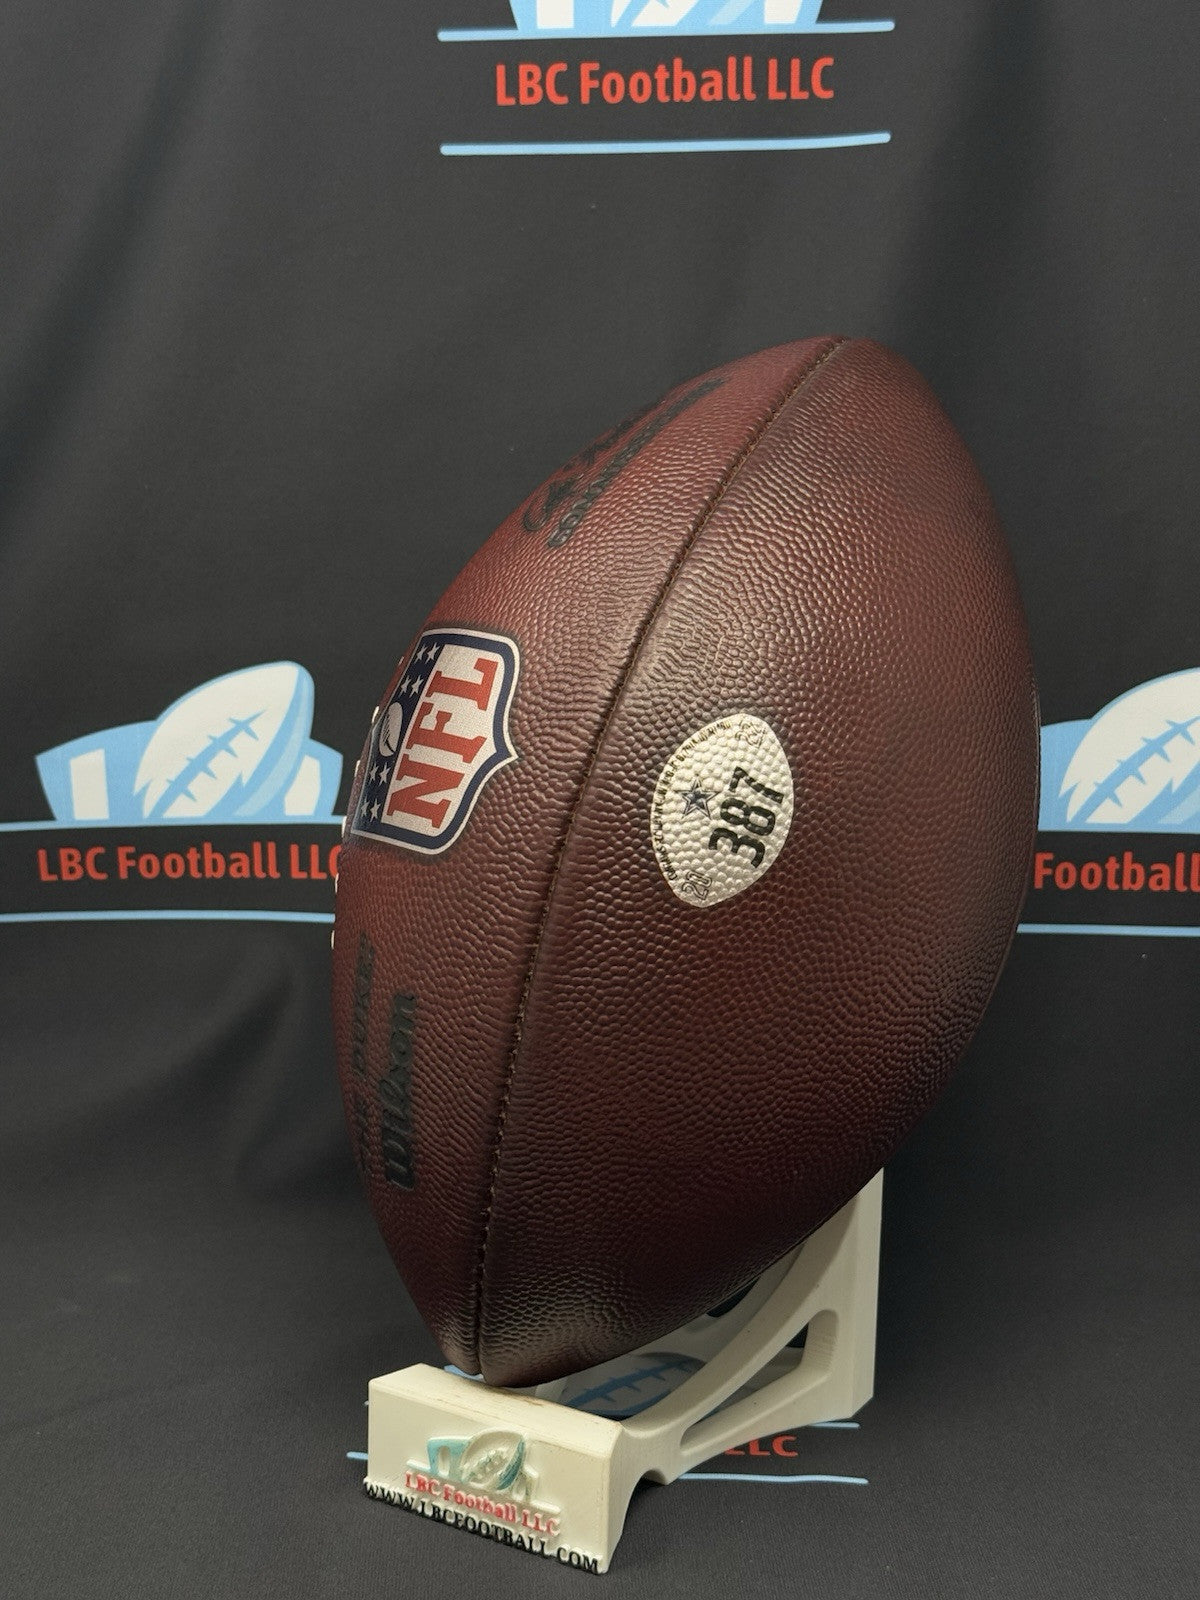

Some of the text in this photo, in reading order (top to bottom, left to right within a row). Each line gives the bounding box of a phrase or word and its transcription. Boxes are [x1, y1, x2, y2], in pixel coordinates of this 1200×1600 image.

[495, 55, 835, 106] LBC Football LLC
[386, 657, 499, 830] NFL
[708, 766, 785, 869] 387
[37, 846, 108, 882] LBC
[117, 841, 280, 880] Football
[681, 870, 713, 900] 20
[1034, 851, 1200, 893] Football
[404, 1470, 561, 1537] LBC Football LLC
